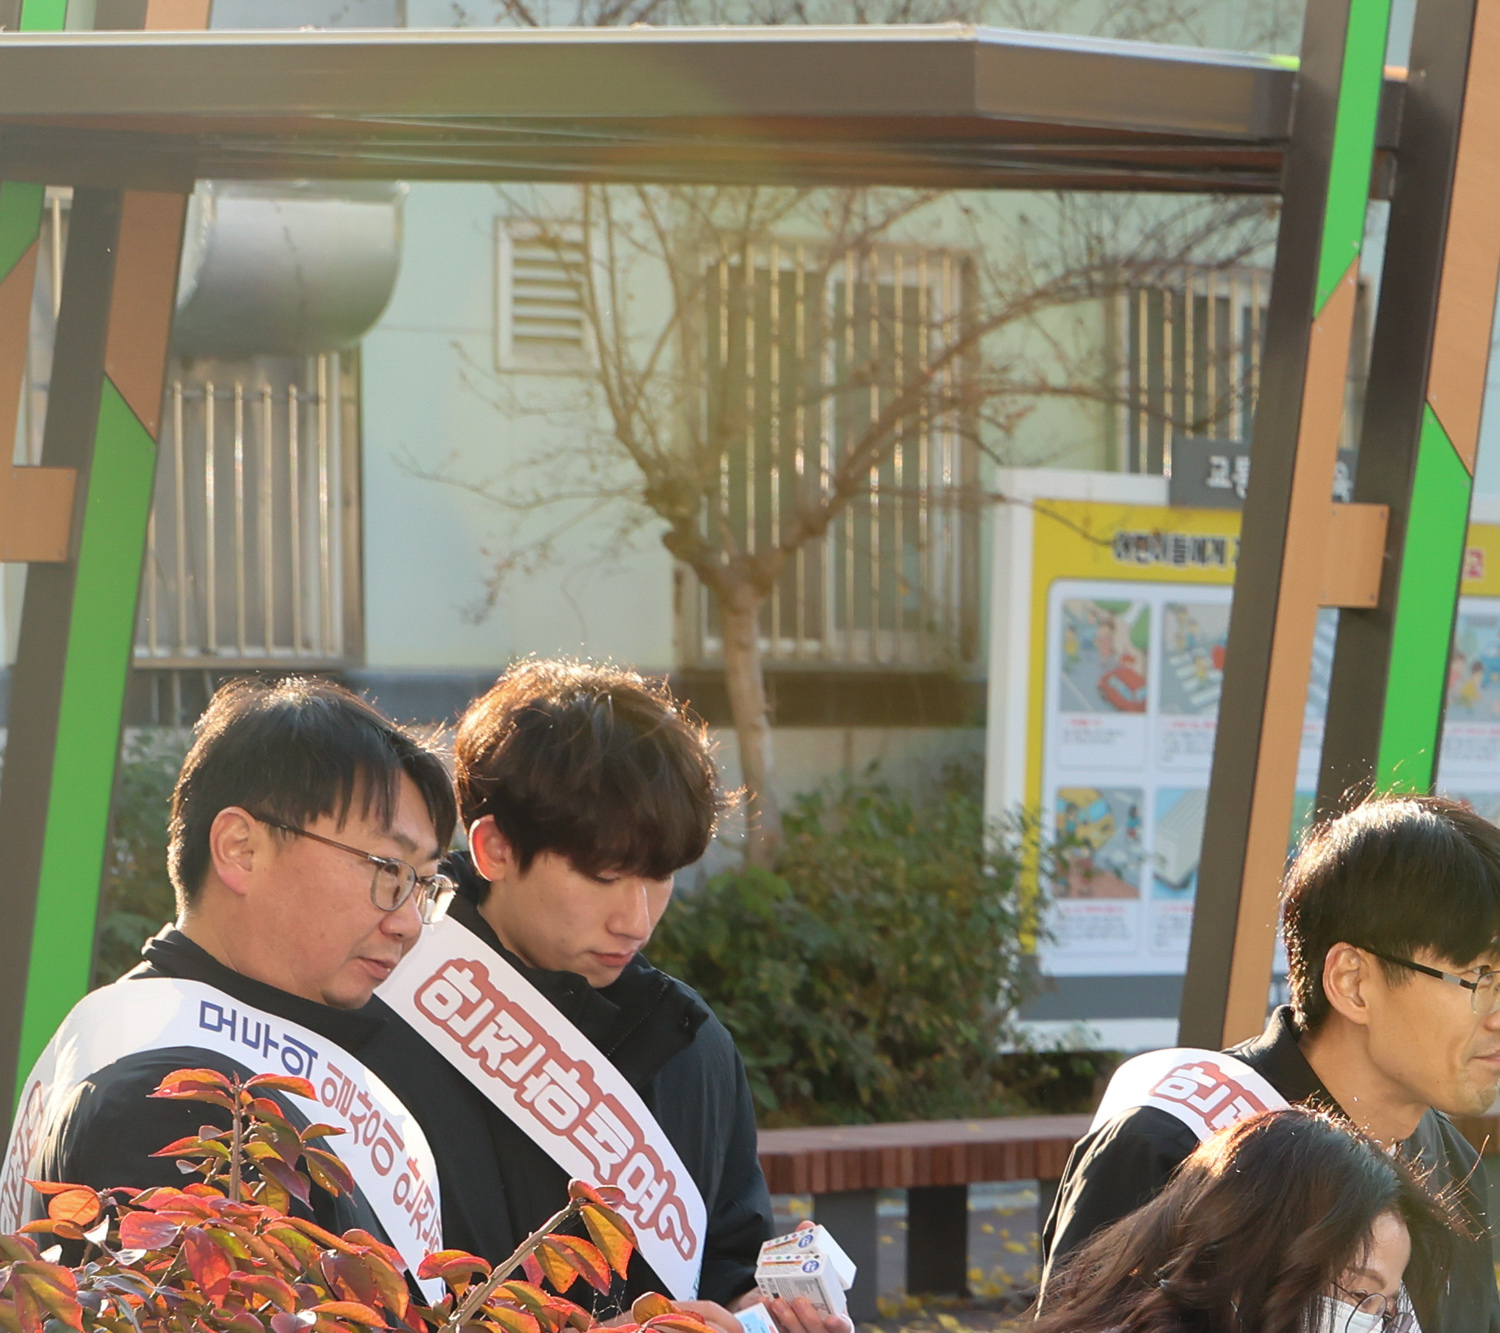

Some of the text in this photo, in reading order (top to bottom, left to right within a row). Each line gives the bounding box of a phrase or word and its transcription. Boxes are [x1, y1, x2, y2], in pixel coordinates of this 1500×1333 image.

[199, 1000, 318, 1079] 모두의
[320, 1062, 405, 1177] 일상이
[414, 957, 697, 1262] 안전하세요?
